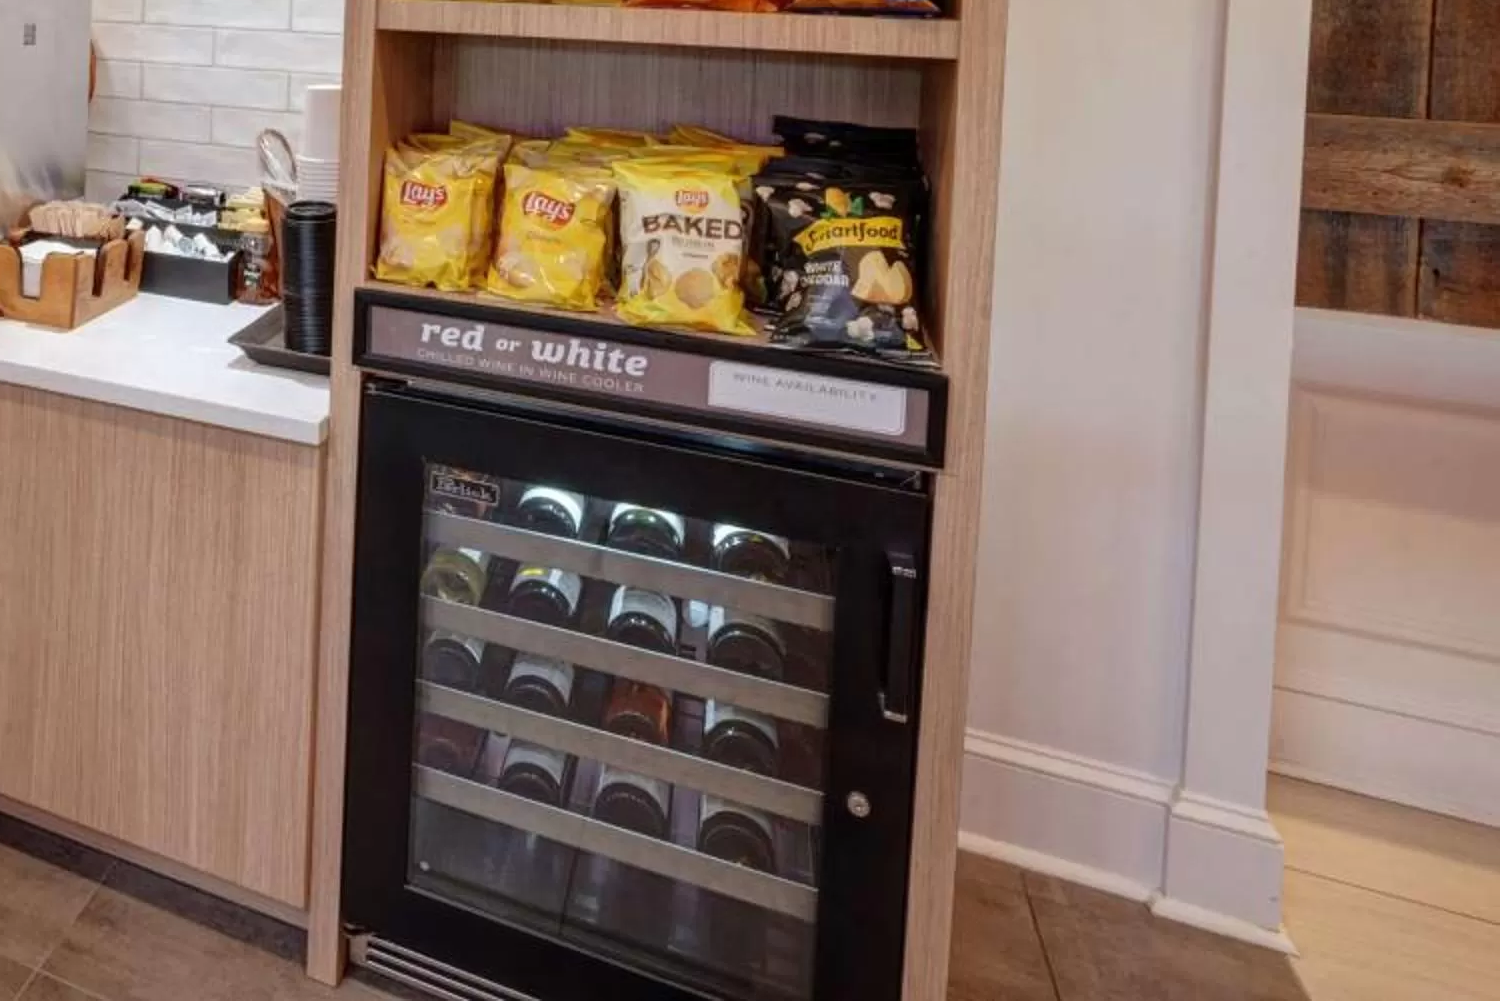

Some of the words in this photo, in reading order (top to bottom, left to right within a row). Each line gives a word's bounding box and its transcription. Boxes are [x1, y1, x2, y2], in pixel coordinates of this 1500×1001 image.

[642, 214, 742, 239] BAKED
[420, 322, 485, 352] red
[495, 337, 522, 352] or
[531, 337, 648, 376] white
[418, 349, 474, 367] CHILLED
[479, 358, 513, 373] WINE
[519, 365, 534, 376] IN
[539, 367, 577, 385] WINE
[582, 374, 645, 393] COOLER
[733, 373, 770, 387] WINE
